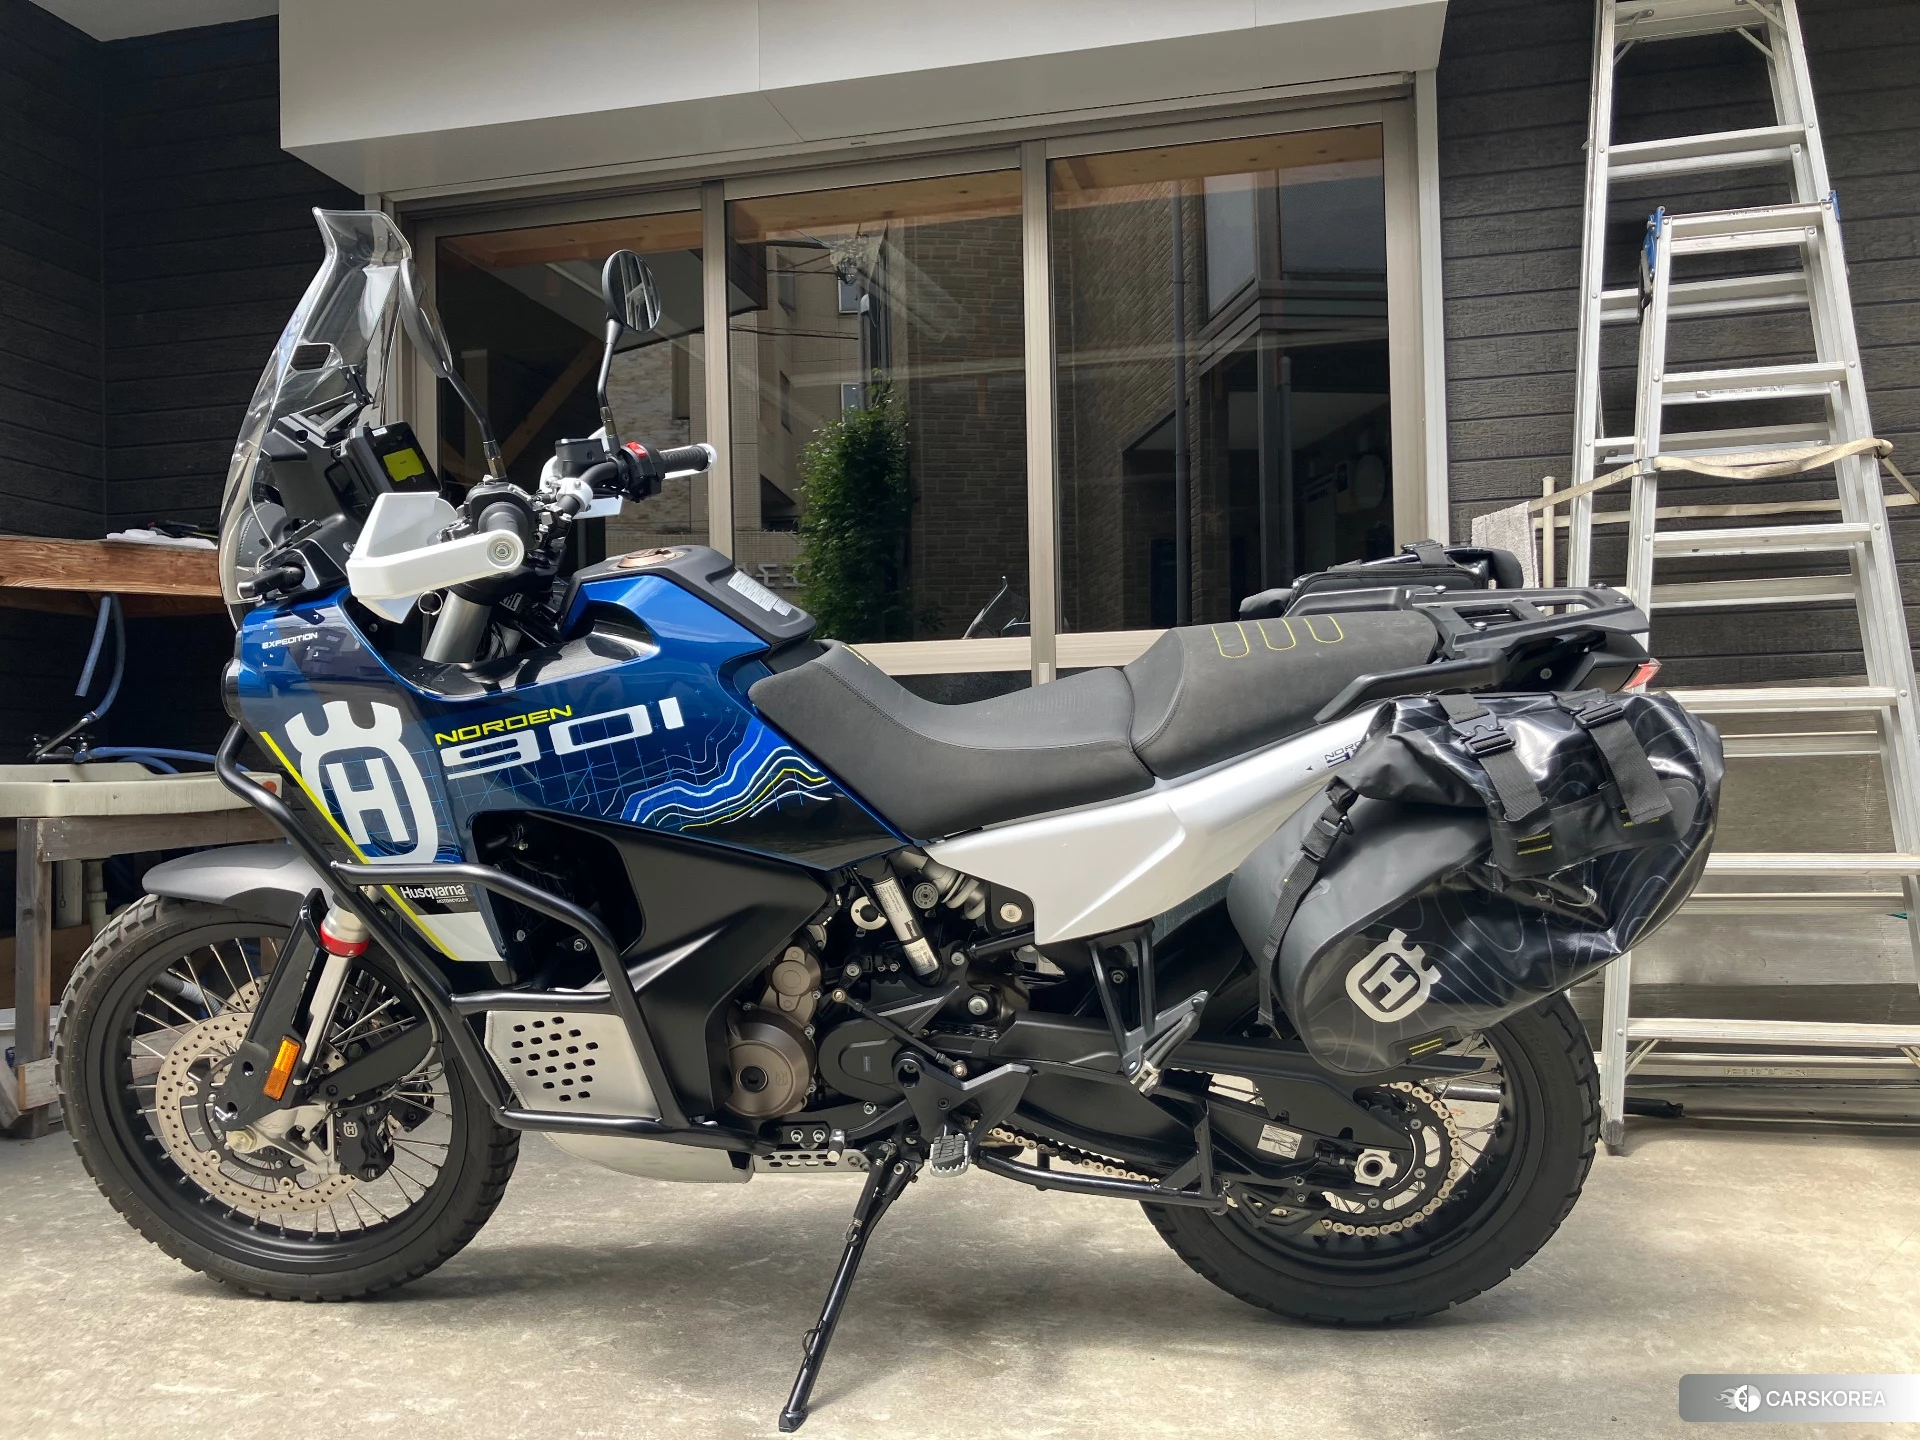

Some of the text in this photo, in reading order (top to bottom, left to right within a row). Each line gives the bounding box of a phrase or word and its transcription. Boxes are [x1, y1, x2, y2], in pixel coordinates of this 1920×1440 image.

[261, 631, 318, 650] EXPEDITION
[435, 704, 573, 746] NORDEN
[439, 696, 685, 781] 901
[400, 884, 466, 900] Husqvarna
